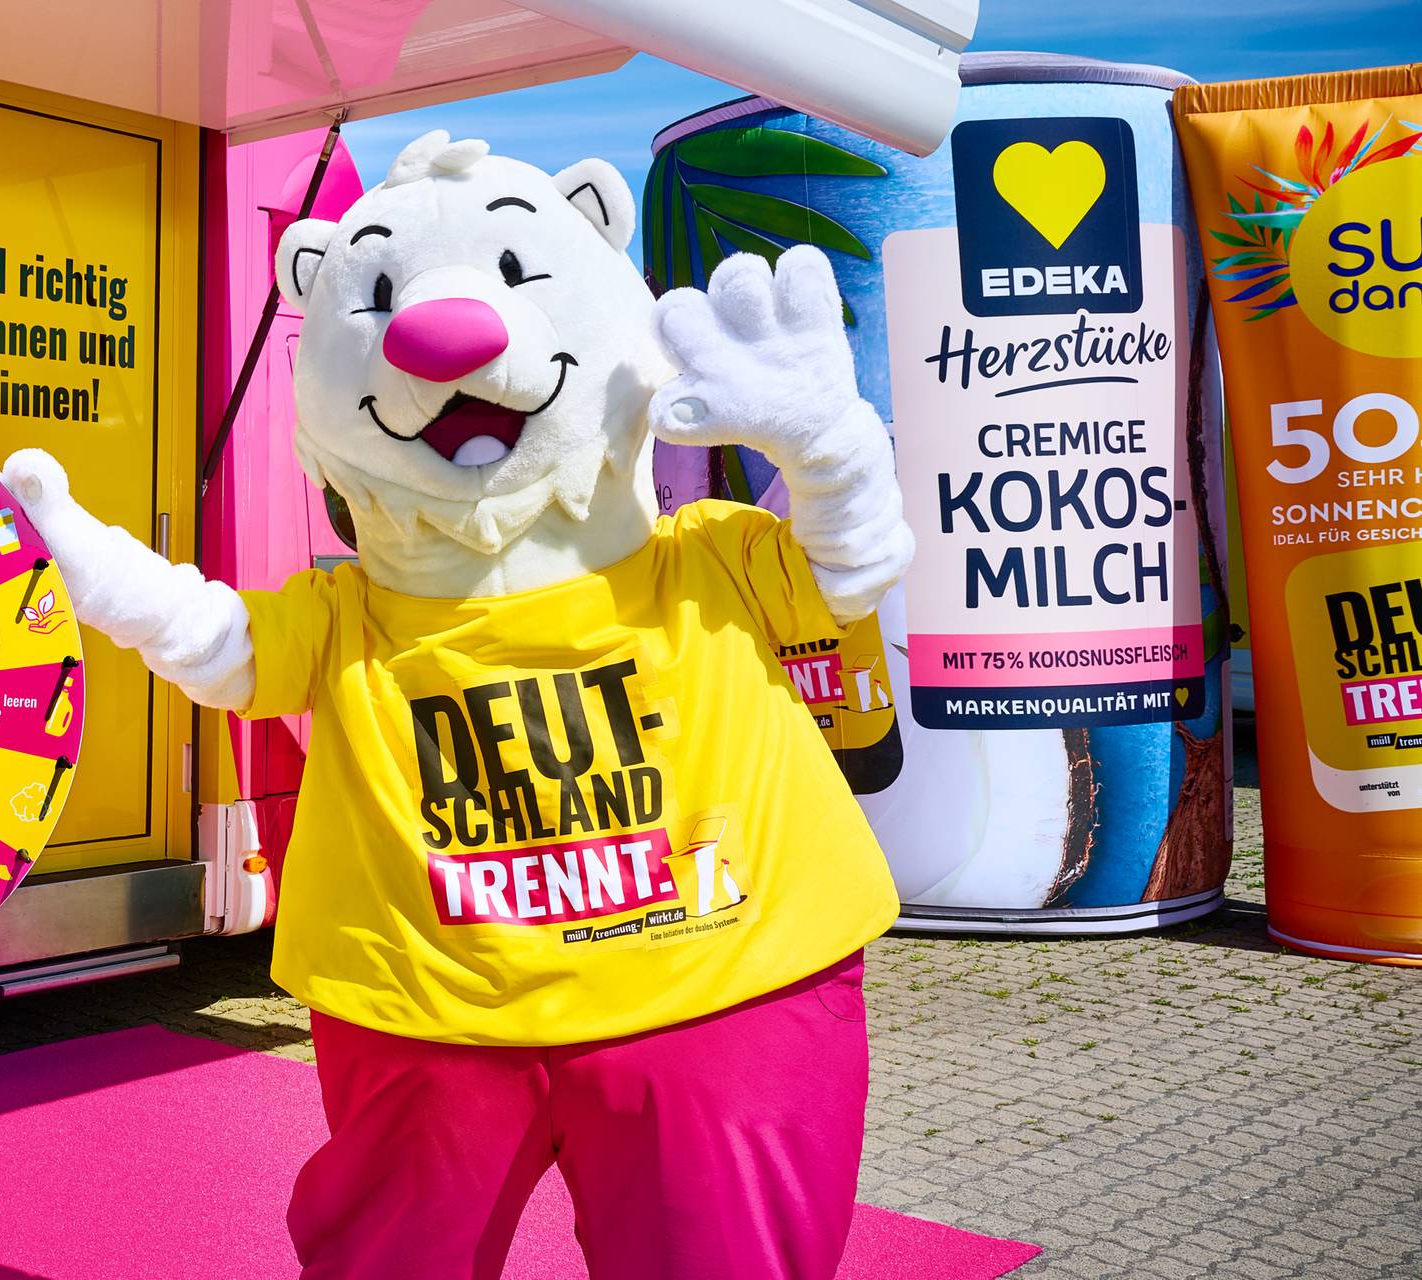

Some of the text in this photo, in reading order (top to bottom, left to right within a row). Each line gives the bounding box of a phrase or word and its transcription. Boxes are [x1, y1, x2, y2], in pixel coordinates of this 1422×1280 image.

[19, 254, 128, 321] richtig
[981, 265, 1128, 297] EDEKA
[79, 324, 135, 368] und
[924, 314, 1171, 389] Herzstücke
[978, 420, 1146, 458] CREMIGE
[1337, 468, 1405, 488] SEHR
[938, 466, 1186, 534] KOKOS-
[1272, 497, 1422, 525] SONNENC
[1273, 531, 1314, 546] IDEAL
[1319, 528, 1351, 543] FÜR
[965, 541, 1168, 609] MILCH
[943, 652, 977, 669] MIT
[1029, 644, 1188, 668] KOKOSNUSSFLEISCH
[3, 693, 37, 708] leeren
[946, 692, 1170, 717] MARKENQUALITÄT MIT
[410, 658, 664, 802] DEUT-
[1370, 735, 1391, 746] müll
[1359, 781, 1399, 791] unterstützt
[420, 766, 663, 850] SCHLAND
[434, 841, 673, 919] TRENNT.
[566, 909, 684, 942] müll trennung- wirkt.de
[650, 932, 662, 941] Eine
[663, 927, 685, 938] Initiative
[686, 926, 694, 935] der
[695, 923, 713, 933] dualen
